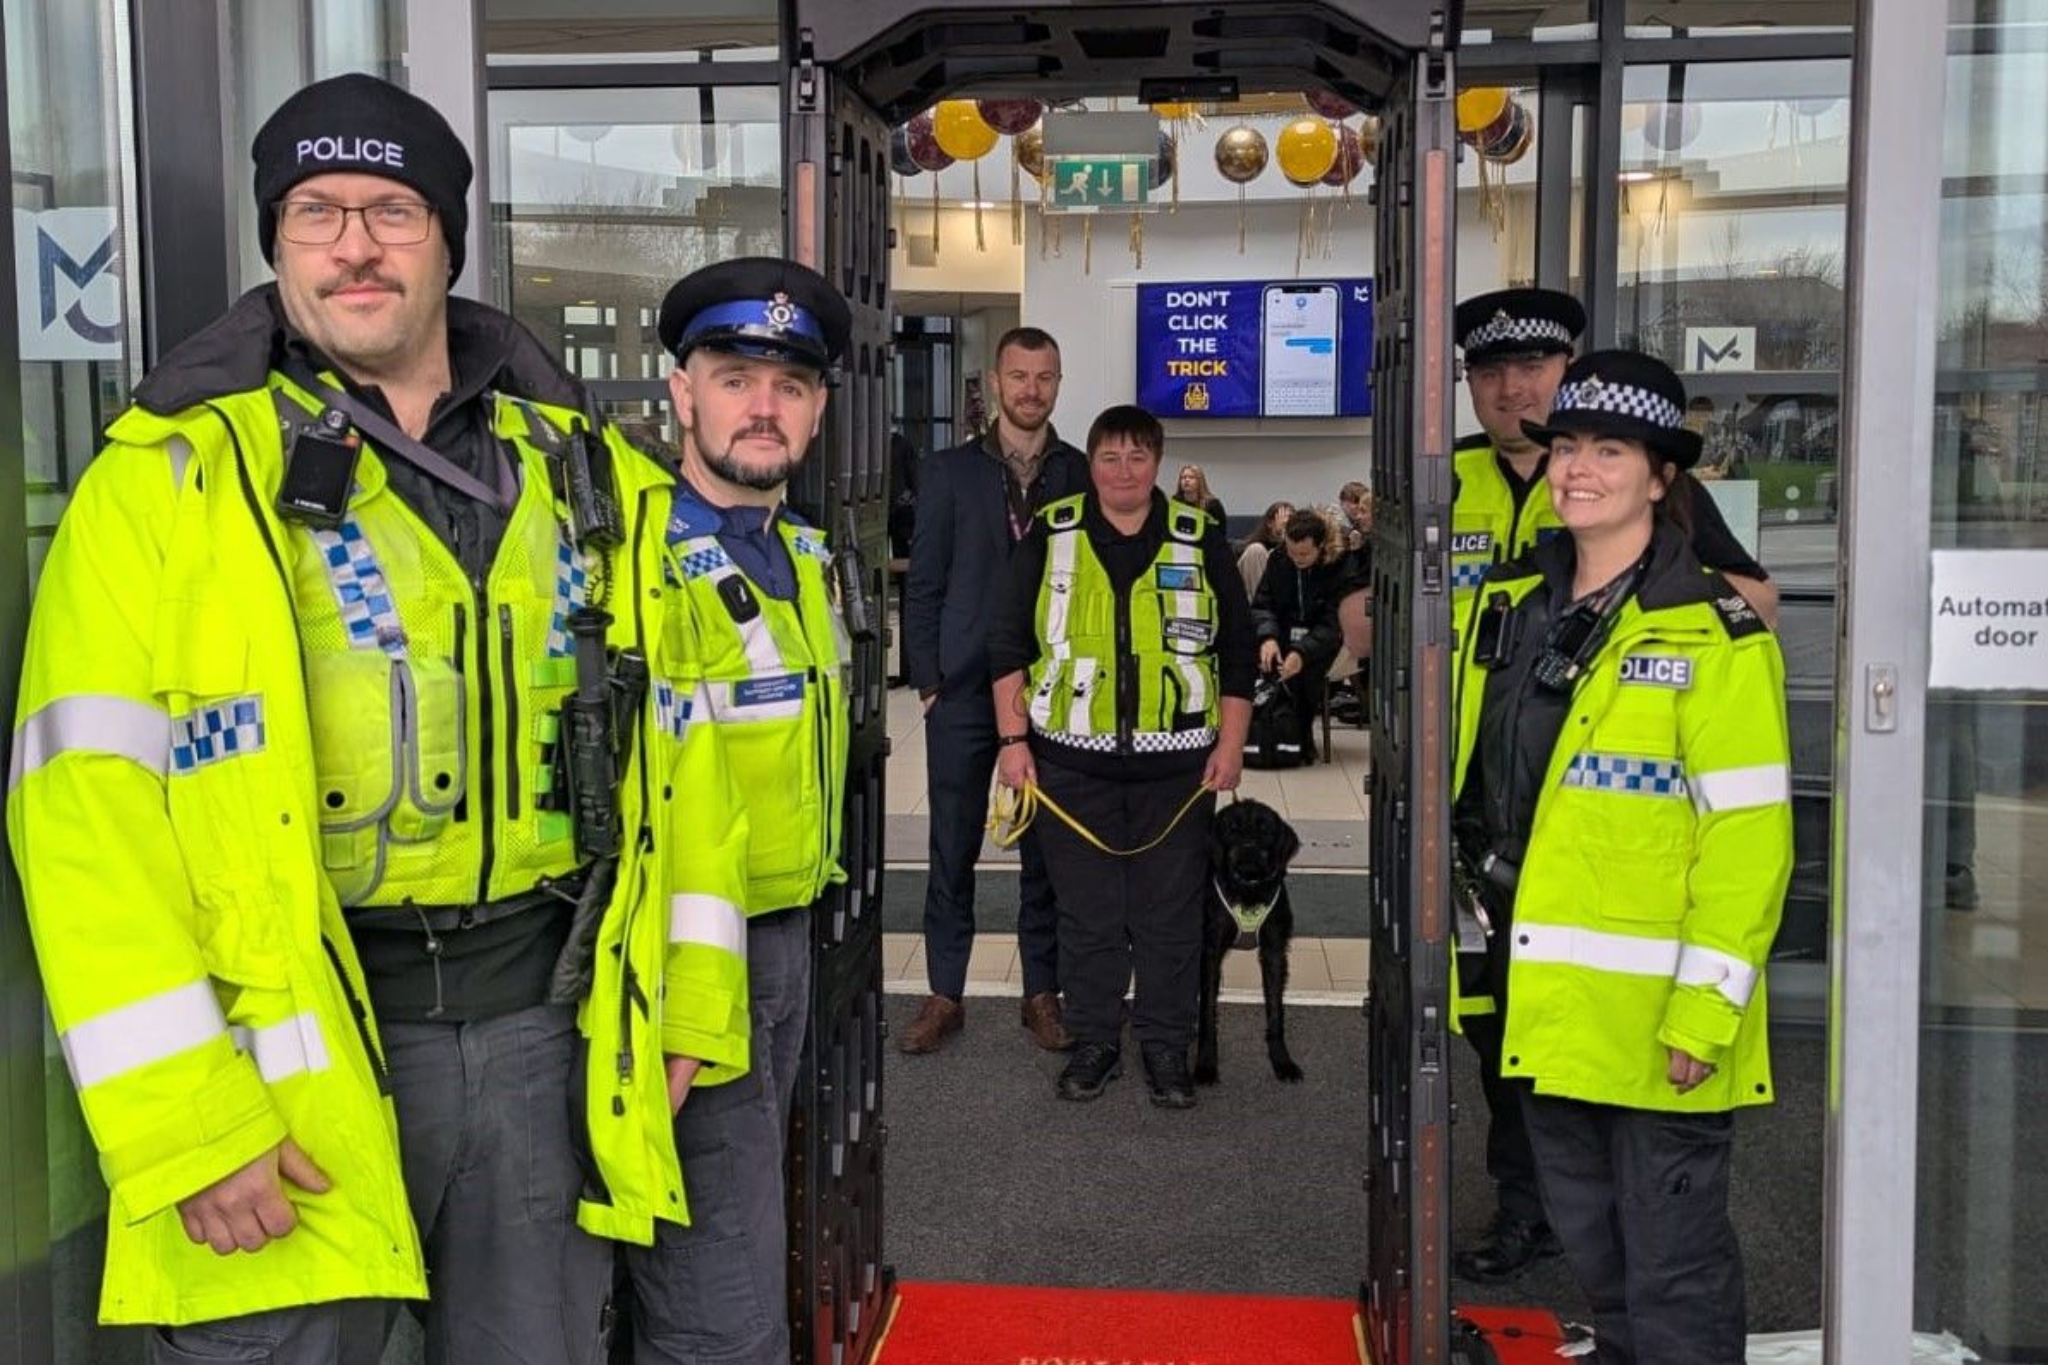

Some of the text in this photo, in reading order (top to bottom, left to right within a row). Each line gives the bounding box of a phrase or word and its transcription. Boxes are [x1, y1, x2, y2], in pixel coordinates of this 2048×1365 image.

[297, 136, 404, 167] POLICE
[1166, 291, 1231, 307] DON'T
[1168, 315, 1228, 330] CLICK
[1177, 338, 1217, 353] THE
[1167, 361, 1228, 376] TRICK
[1974, 626, 2038, 646] door
